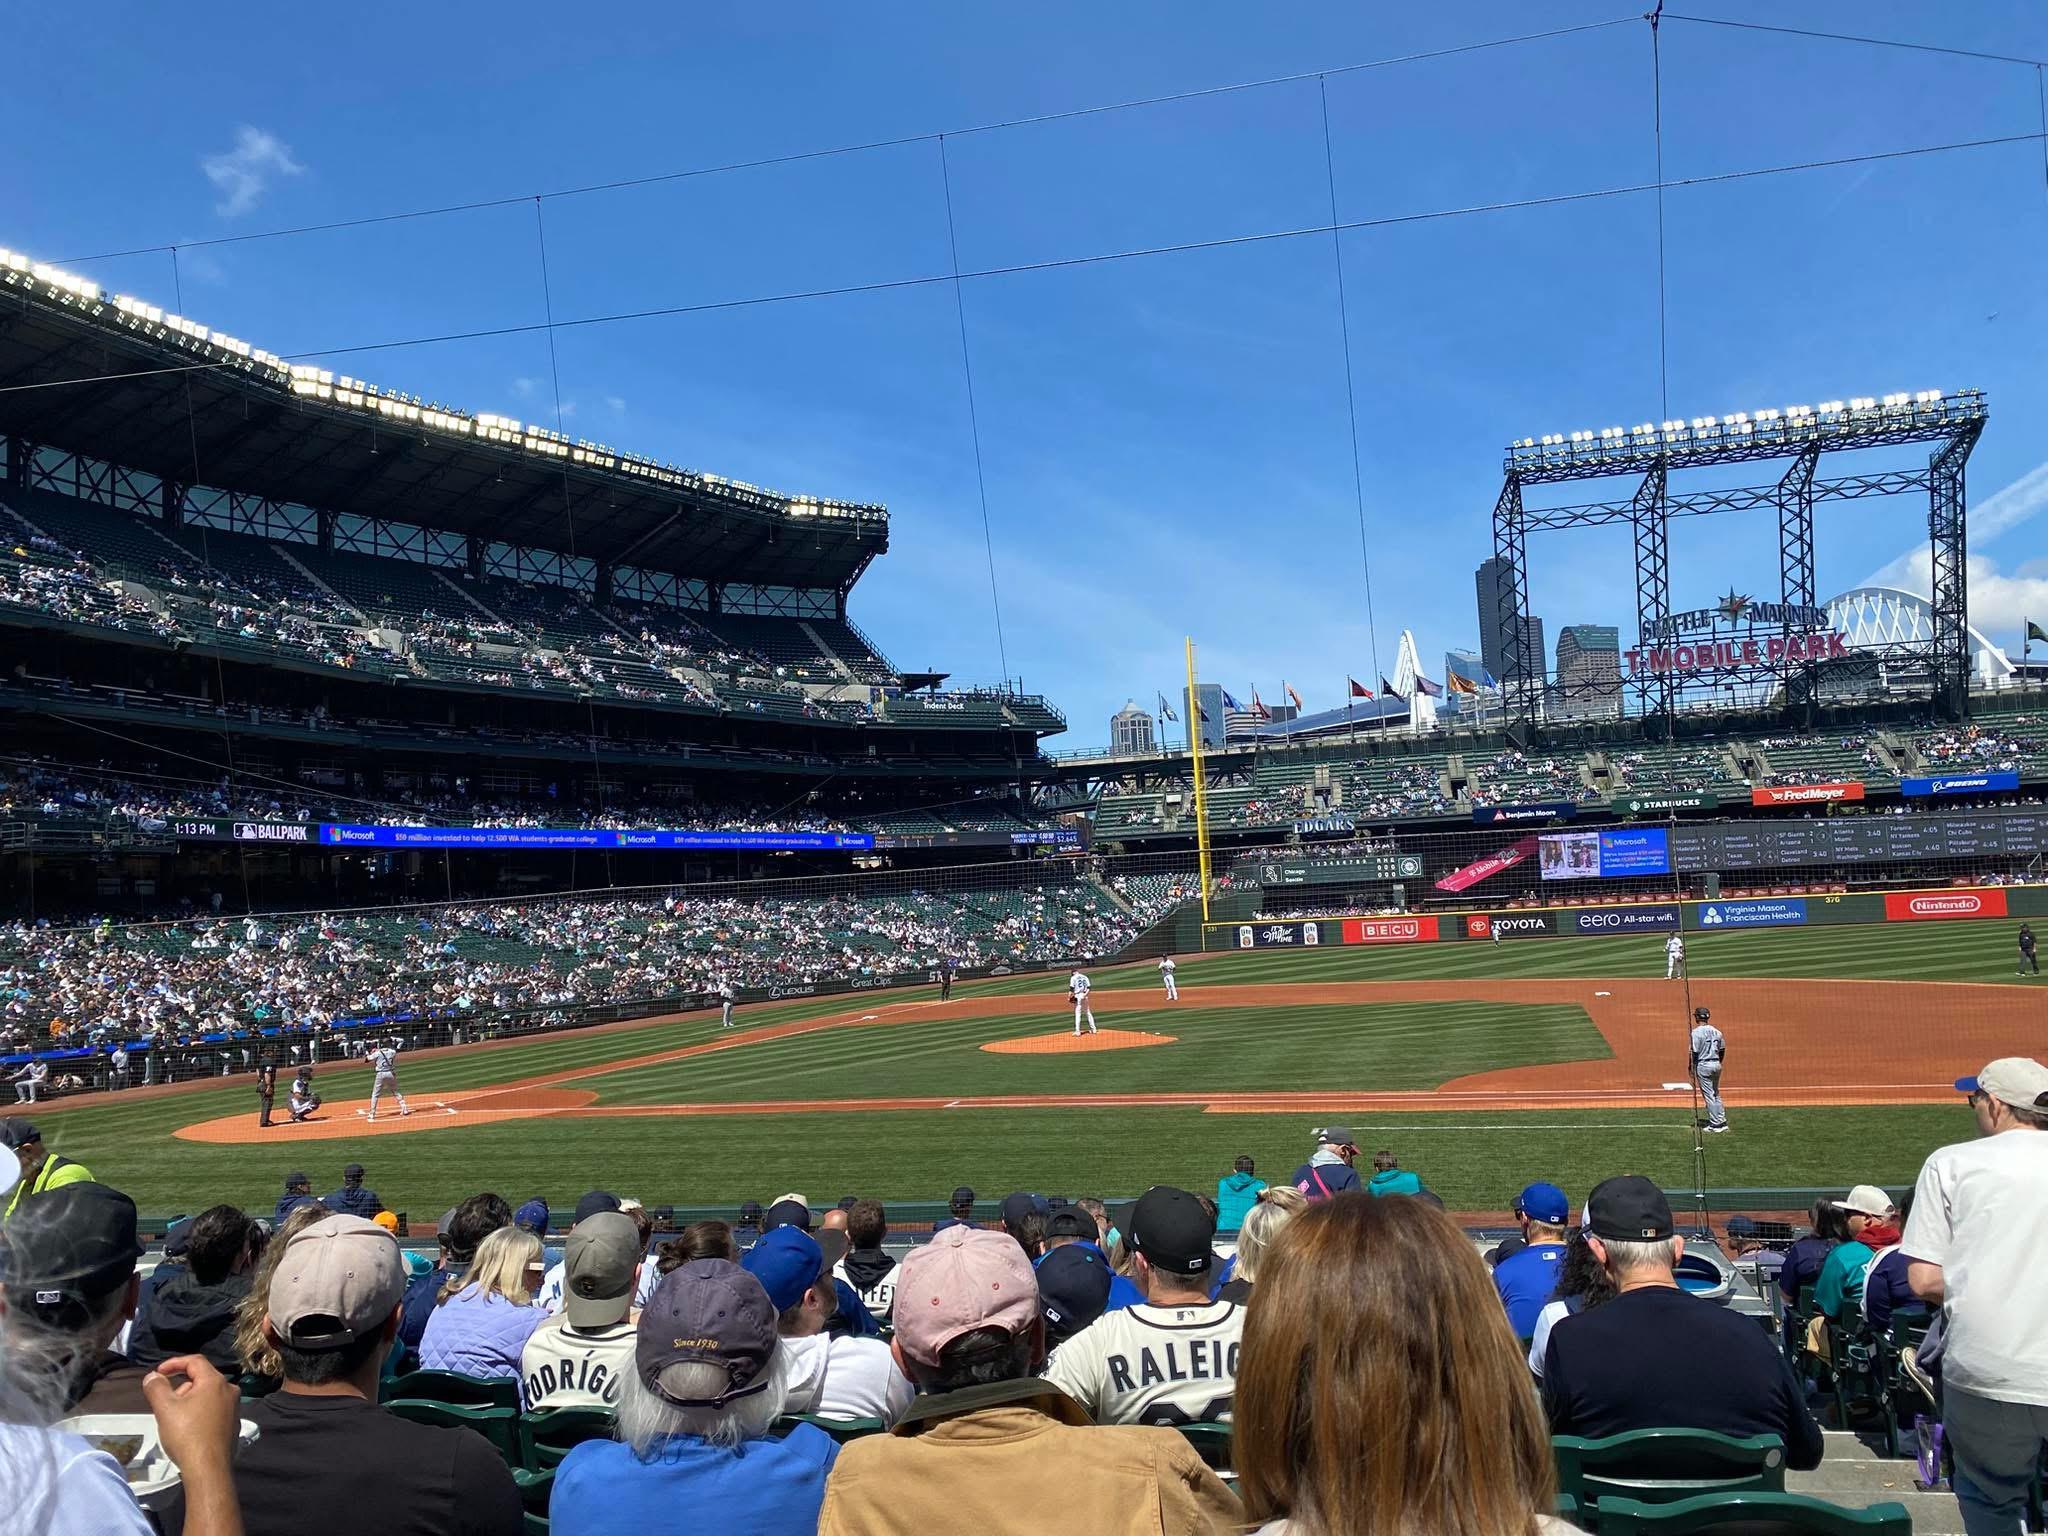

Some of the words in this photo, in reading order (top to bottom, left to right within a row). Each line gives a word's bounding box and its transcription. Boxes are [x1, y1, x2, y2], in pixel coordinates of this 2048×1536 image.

[1641, 608, 1711, 642] SEATTLE
[1750, 601, 1829, 626] MARINERS
[1623, 639, 1761, 674] T-MOBILE
[1767, 632, 1850, 663] PARK
[1945, 779, 1988, 788] BOEING
[1505, 811, 1535, 820] Benjamin
[1536, 808, 1557, 817] Moore
[175, 822, 197, 834] 1:13
[199, 823, 216, 835] PM
[1293, 818, 1355, 834] EDGARS
[257, 824, 307, 840] BALLPARK
[342, 830, 375, 841] Microsoft
[627, 835, 656, 843] Microsoft
[843, 837, 865, 845] Microsoft
[1613, 837, 1648, 847] Microsoft
[1724, 904, 1756, 915] Virginia
[1757, 903, 1786, 912] Mason
[1916, 900, 1973, 911] Nintendo
[1579, 914, 1621, 928] eero
[1623, 914, 1656, 924] All-star
[1656, 913, 1675, 922] wifi.
[1725, 912, 1771, 922] Franciscan
[1771, 911, 1801, 920] Health
[1493, 919, 1546, 930] TOYOTA
[851, 979, 873, 988] Great
[873, 976, 892, 986] Clips
[781, 985, 815, 996] LEXUS
[673, 1338, 696, 1348] Since
[696, 1338, 719, 1349] 1930
